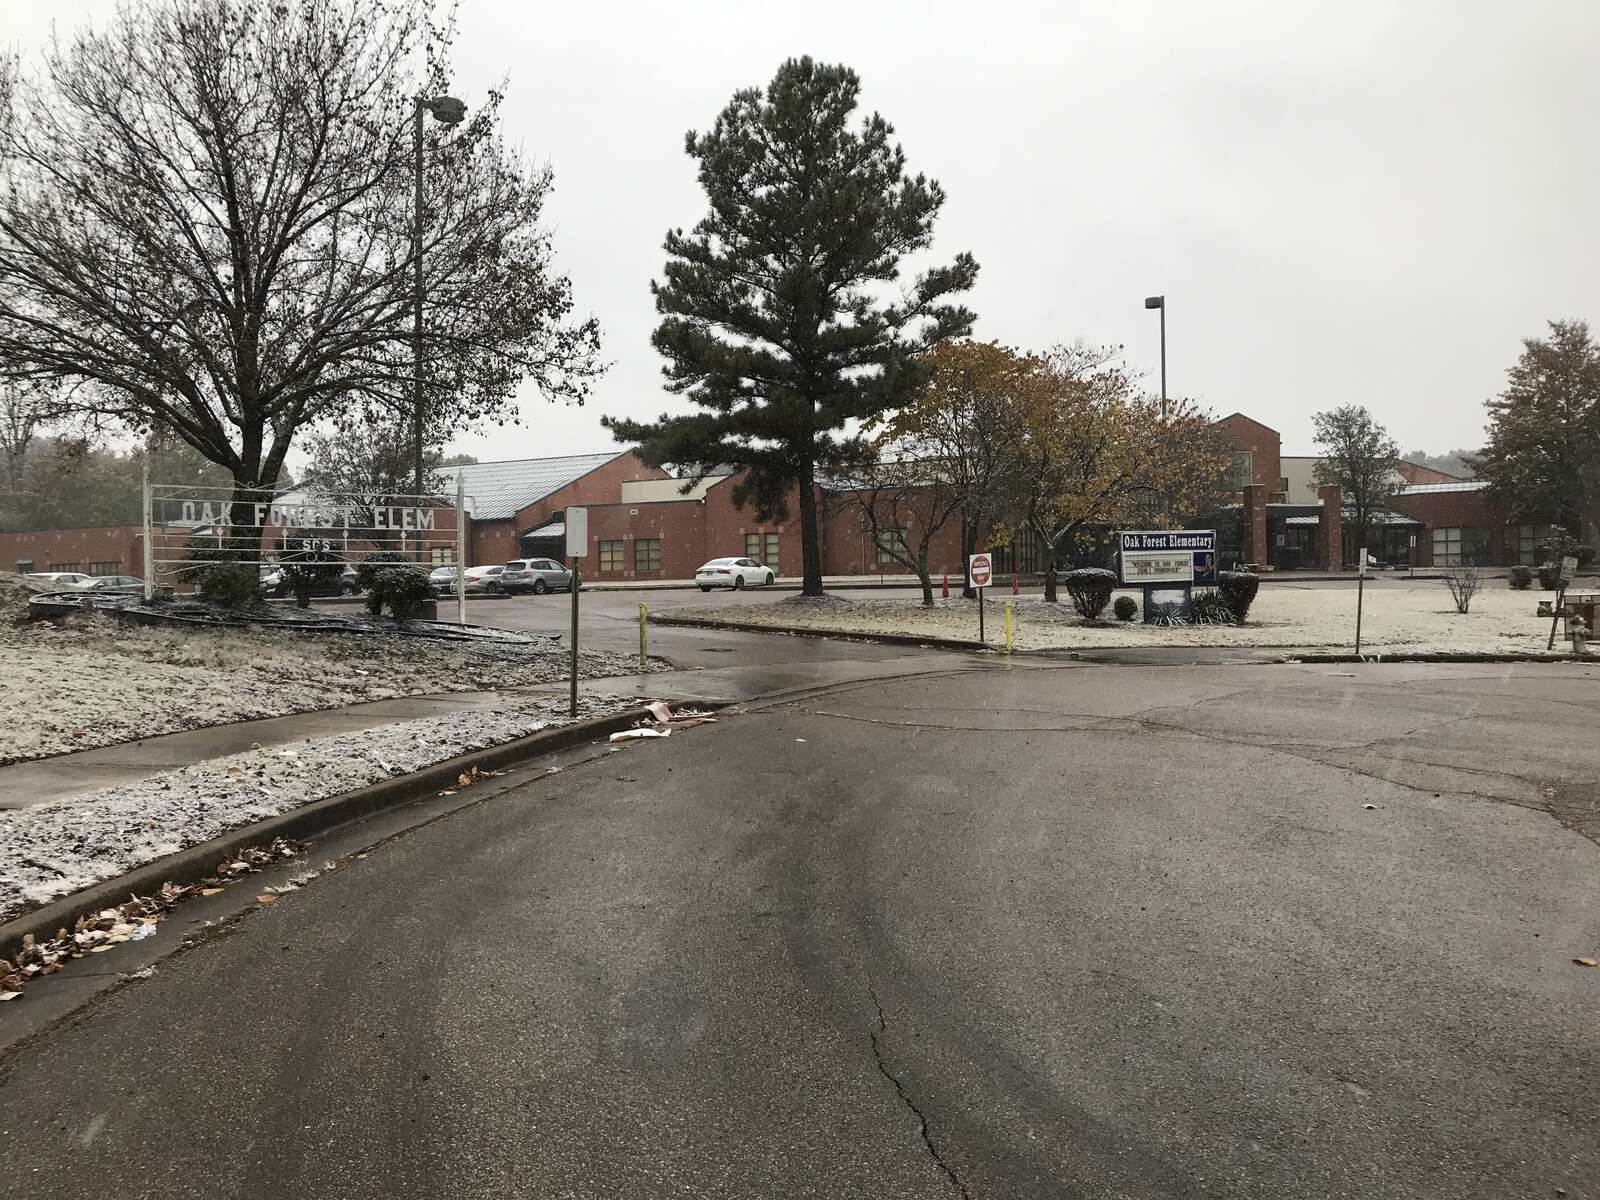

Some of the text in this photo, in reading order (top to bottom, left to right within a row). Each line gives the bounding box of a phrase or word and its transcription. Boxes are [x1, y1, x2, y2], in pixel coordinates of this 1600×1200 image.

[182, 501, 435, 530] OAK FOREST ELEM
[1124, 534, 1213, 550] Oak Forest Elementary
